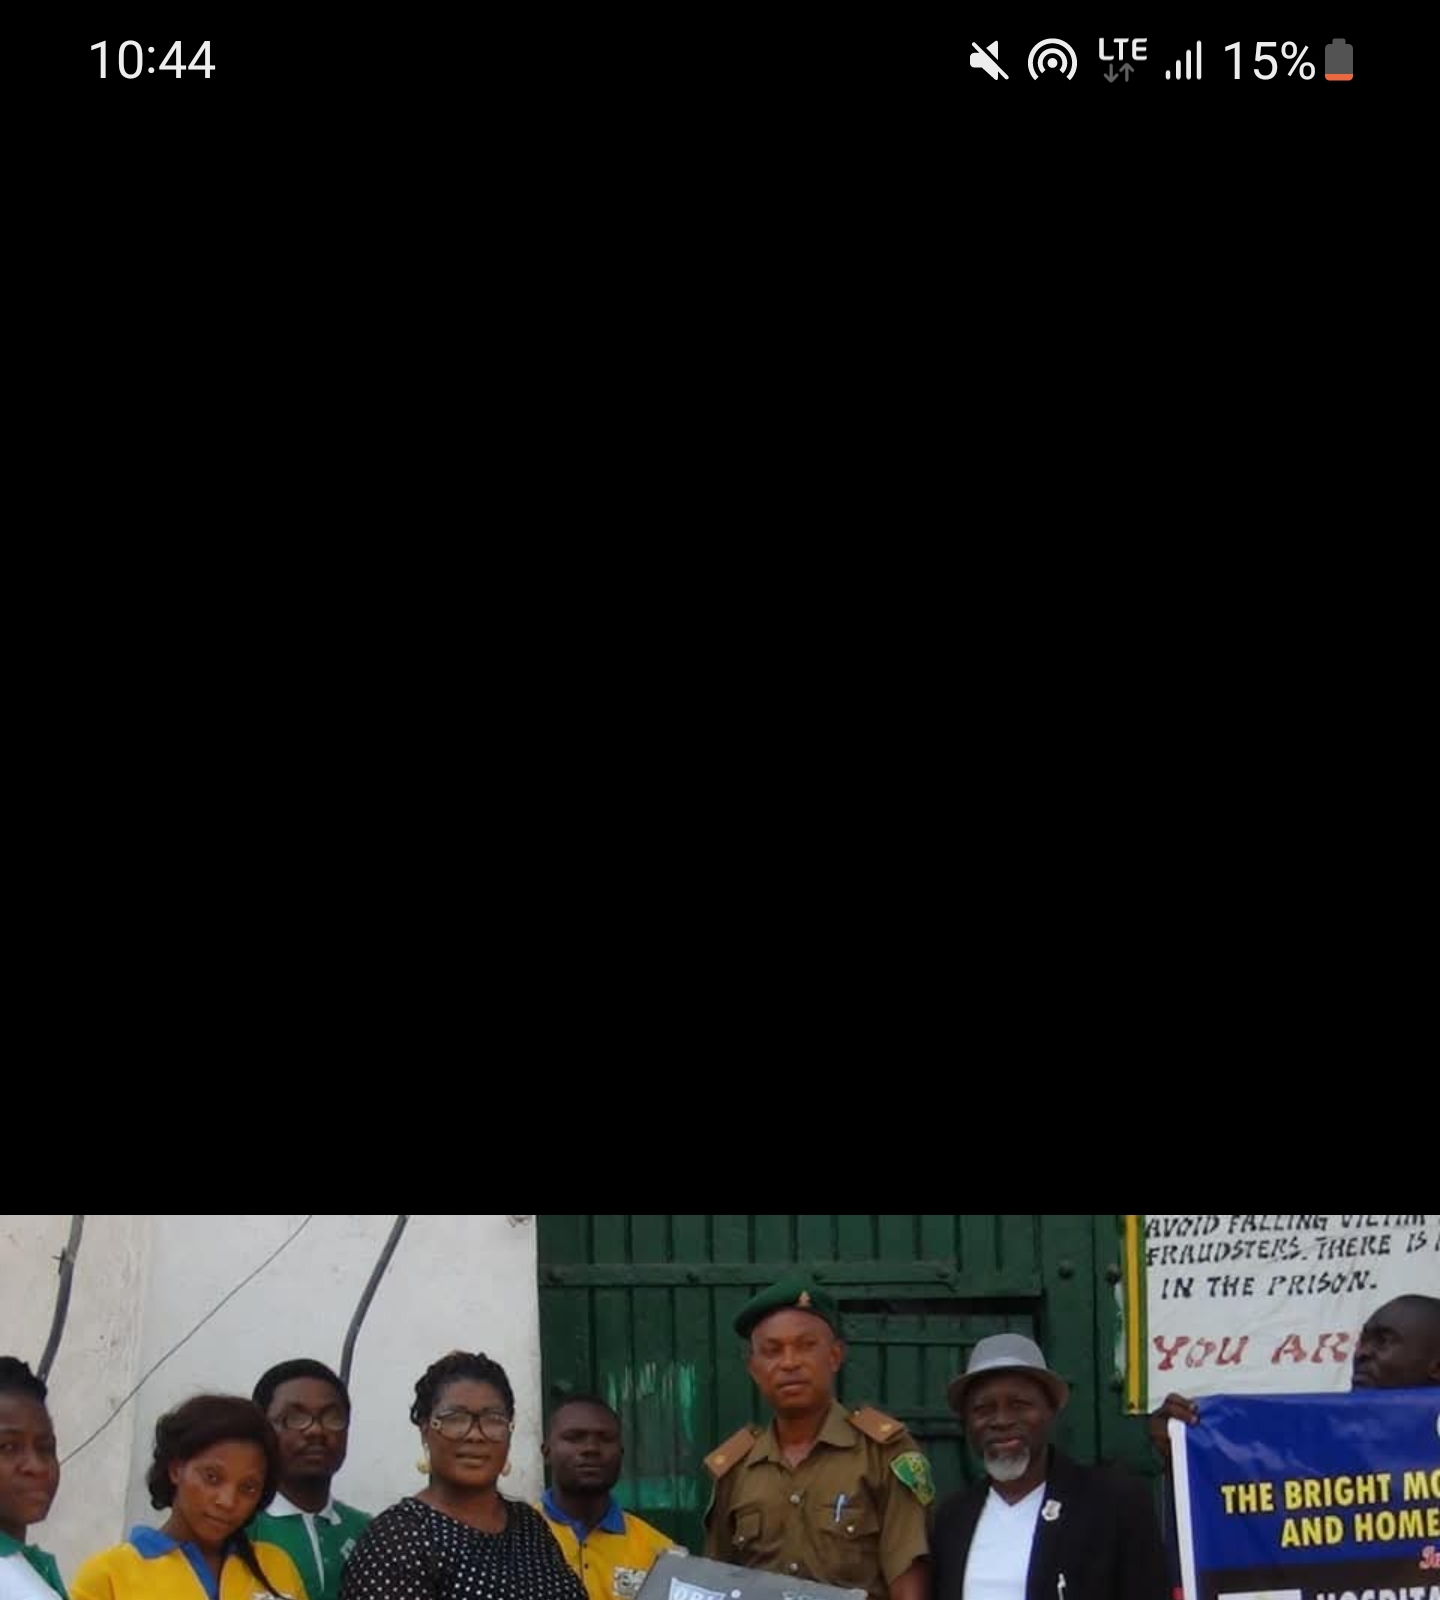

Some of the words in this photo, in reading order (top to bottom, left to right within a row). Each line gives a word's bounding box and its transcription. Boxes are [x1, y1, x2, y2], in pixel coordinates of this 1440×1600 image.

[1145, 1216, 1220, 1238] AVOID
[1228, 1215, 1328, 1234] FALLING
[1316, 1235, 1392, 1261] THERE
[1406, 1231, 1428, 1253] IS
[1161, 1277, 1195, 1300] IN
[1207, 1275, 1256, 1298] THE
[1268, 1271, 1378, 1297] PRISON.
[1153, 1335, 1249, 1371] YOU
[1221, 1482, 1275, 1515] THE
[1284, 1473, 1392, 1511] BRIGHT
[1281, 1516, 1344, 1548] AND
[1354, 1507, 1440, 1543] HOME
